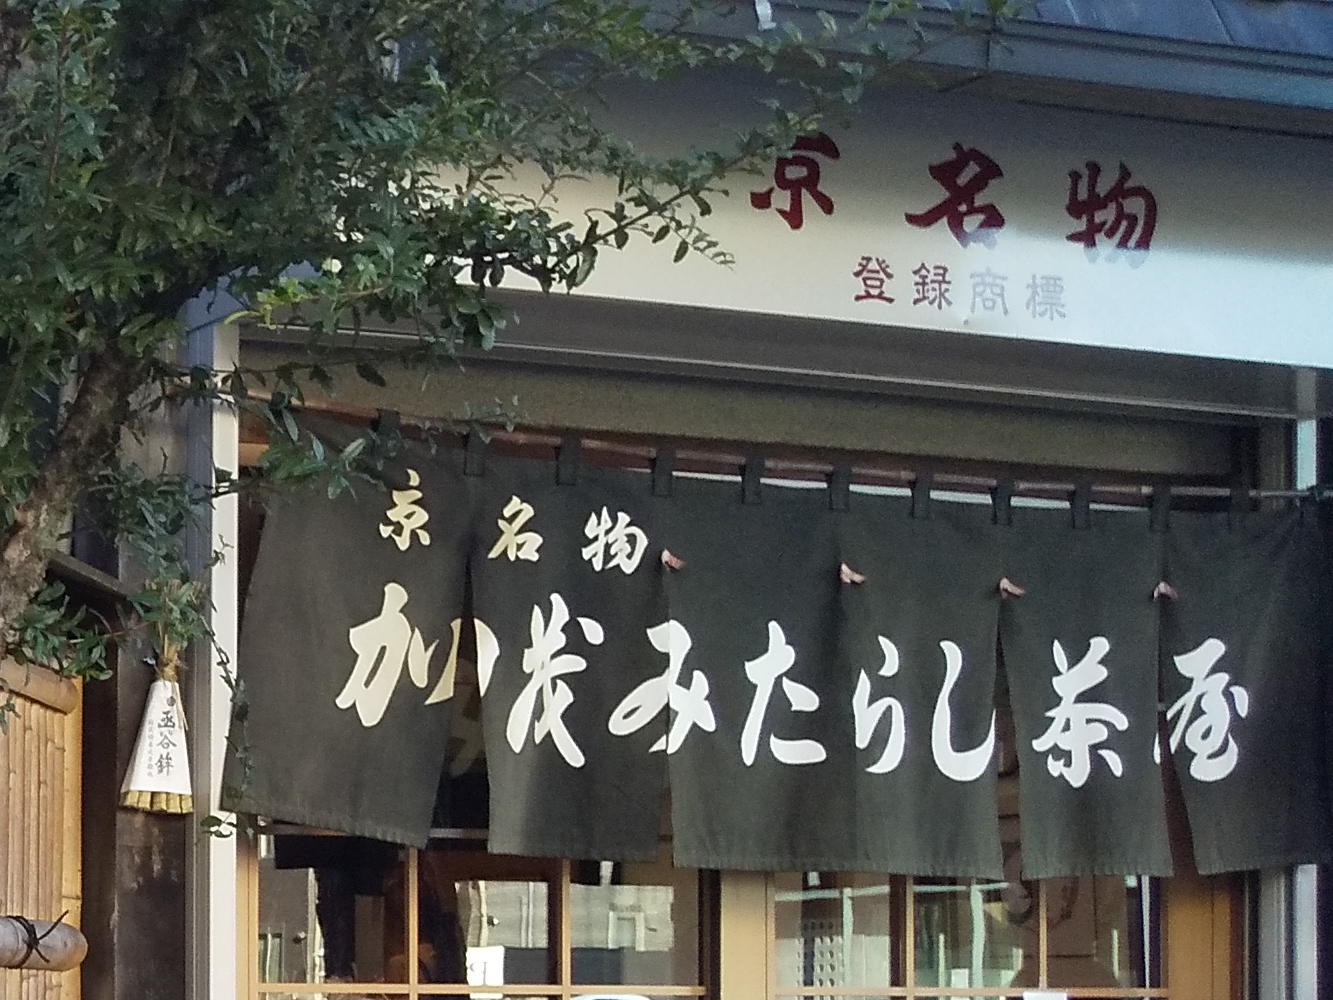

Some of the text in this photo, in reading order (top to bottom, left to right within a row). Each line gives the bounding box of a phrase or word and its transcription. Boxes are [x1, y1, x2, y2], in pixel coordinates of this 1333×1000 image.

[749, 130, 1160, 270] 京名物
[852, 253, 1068, 323] 登録商標
[377, 469, 649, 574] 京名物
